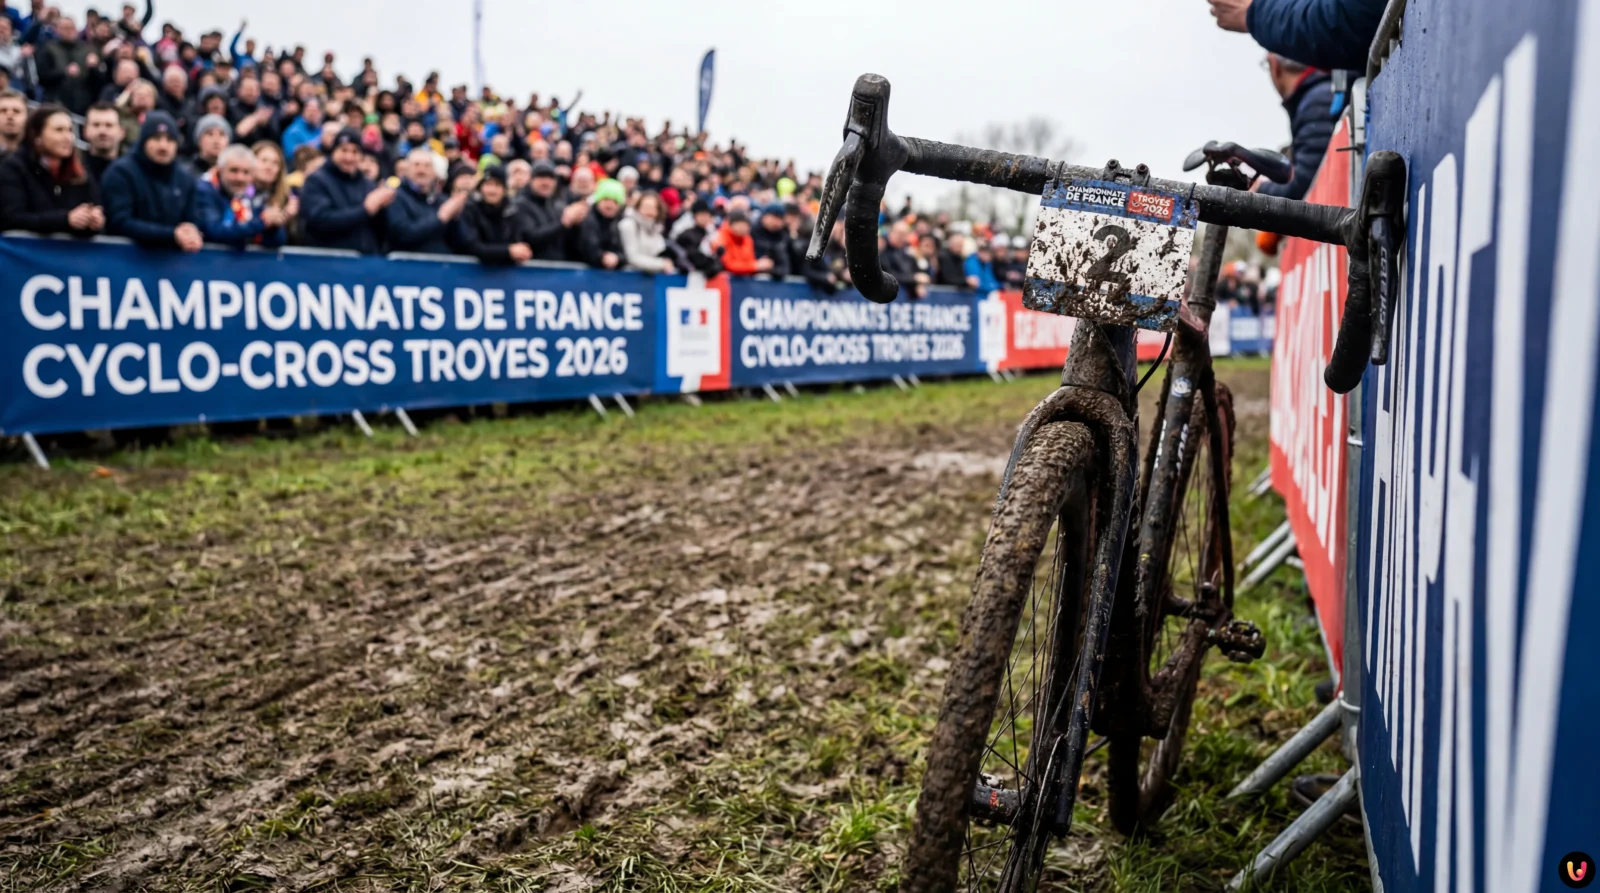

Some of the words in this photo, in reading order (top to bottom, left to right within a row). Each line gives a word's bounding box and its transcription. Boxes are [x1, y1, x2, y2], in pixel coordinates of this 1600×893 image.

[1066, 192, 1081, 201] DE
[1082, 194, 1126, 207] FRANCE
[1142, 203, 1169, 215] 2026
[1087, 224, 1131, 284] 2
[20, 274, 446, 331] CHAMPIONNATS
[454, 287, 507, 330] DE
[514, 289, 643, 331] FRANCE
[740, 296, 889, 331] CHAMPIONNATS
[22, 337, 396, 399] CYCLO-CROSS
[403, 337, 549, 383] TROYES
[555, 336, 629, 377] 2026
[740, 333, 870, 368] CYCLO-CROSS
